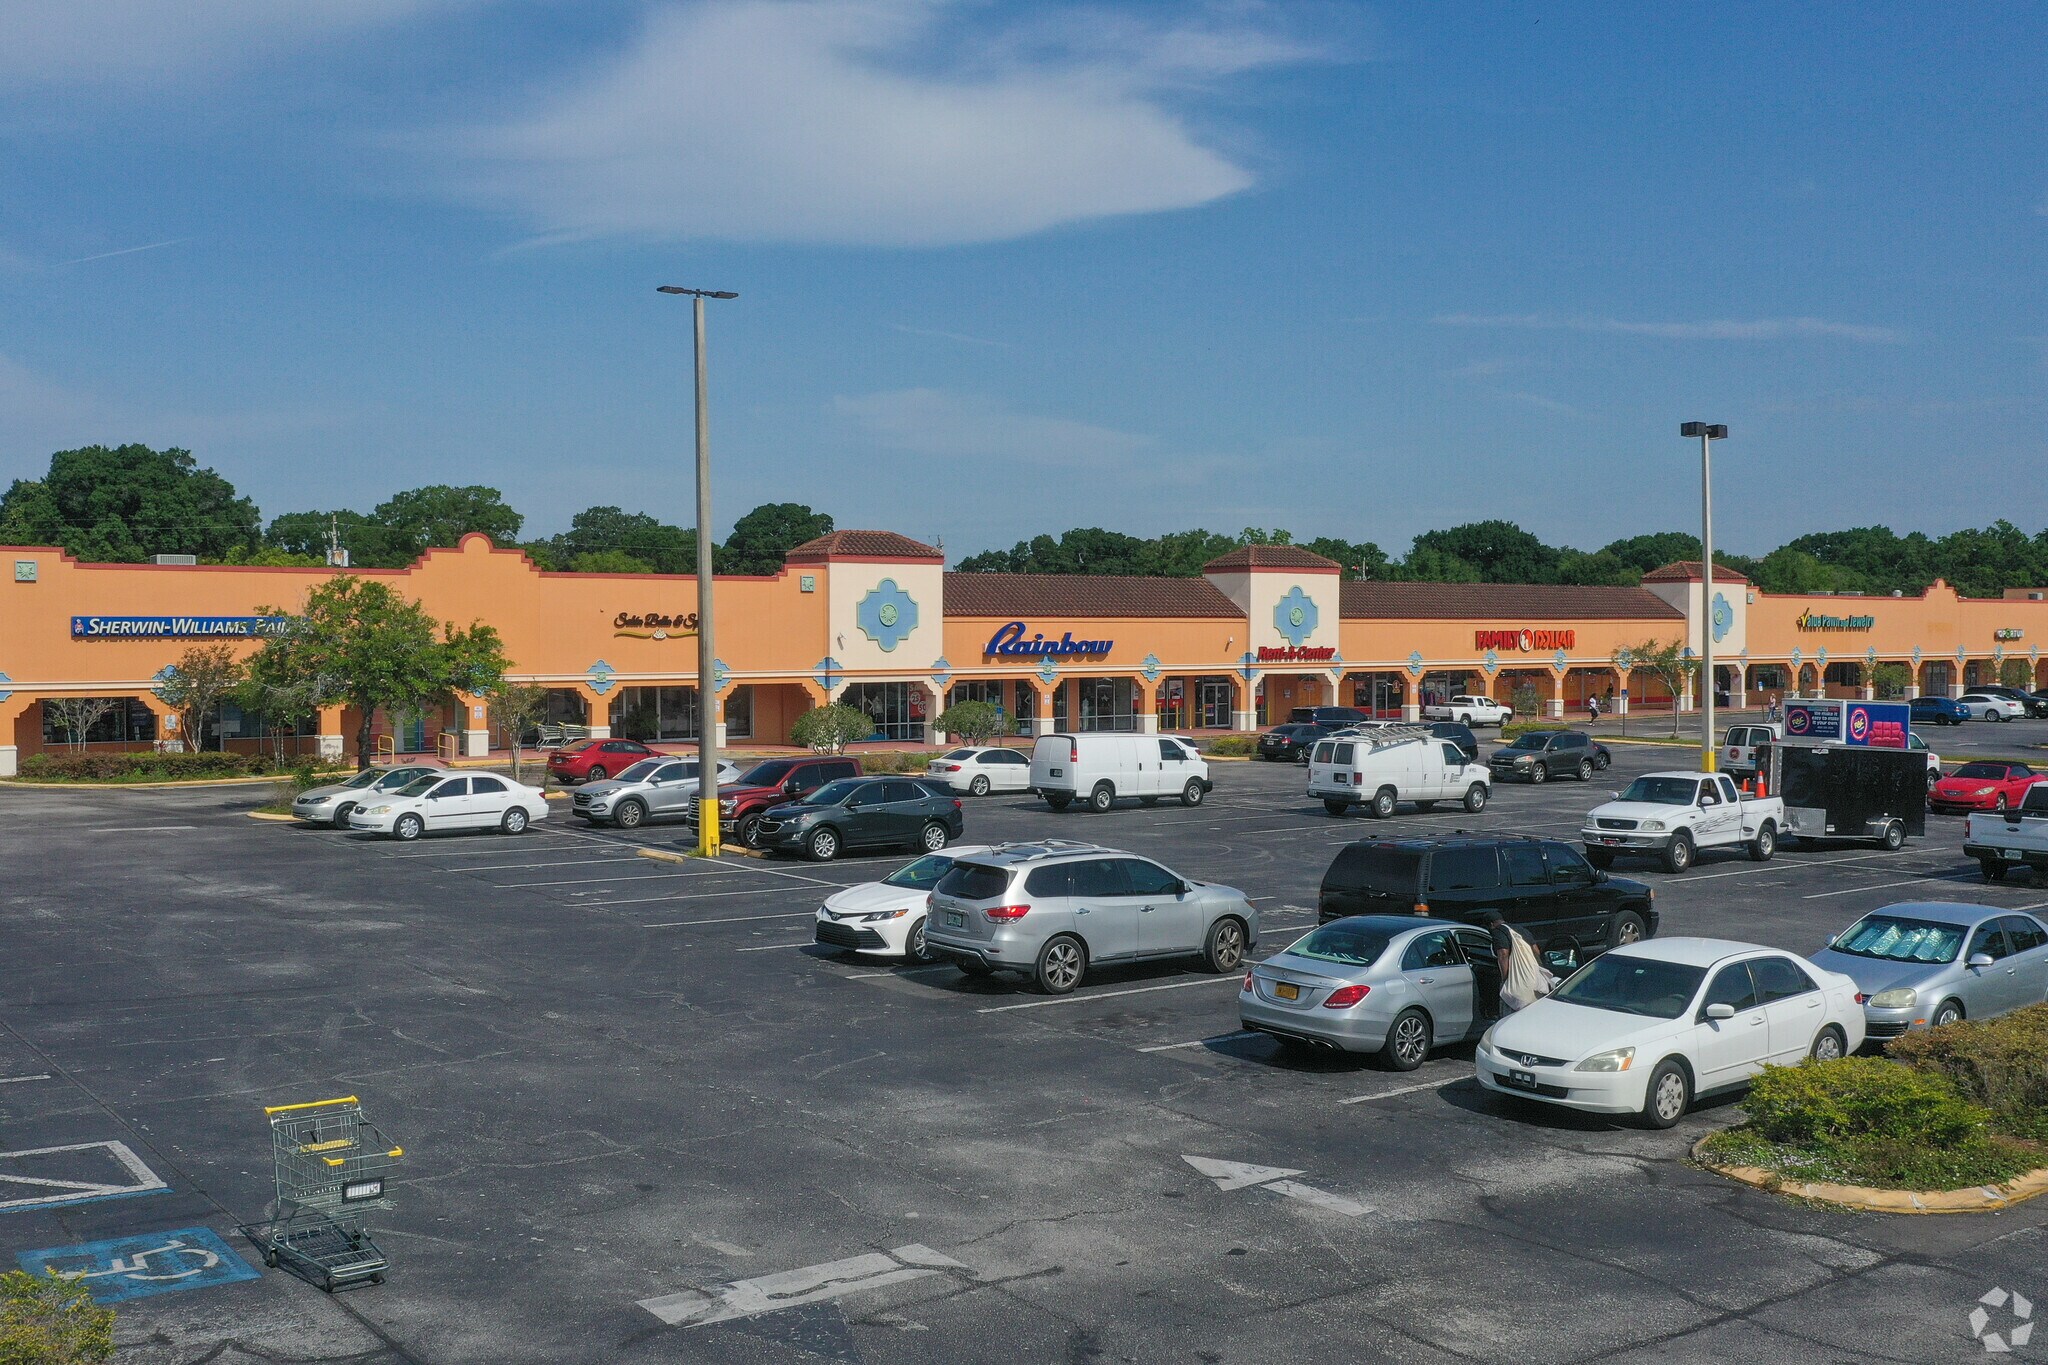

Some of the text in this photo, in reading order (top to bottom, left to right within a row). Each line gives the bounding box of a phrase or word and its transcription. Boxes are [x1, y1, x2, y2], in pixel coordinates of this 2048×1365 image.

[87, 618, 248, 635] SHERWIN-WILLIAMS
[985, 621, 1114, 655] Rainbow
[1475, 629, 1576, 650] FAMILY DOLLAR
[1257, 645, 1335, 661] Rent-A-Center
